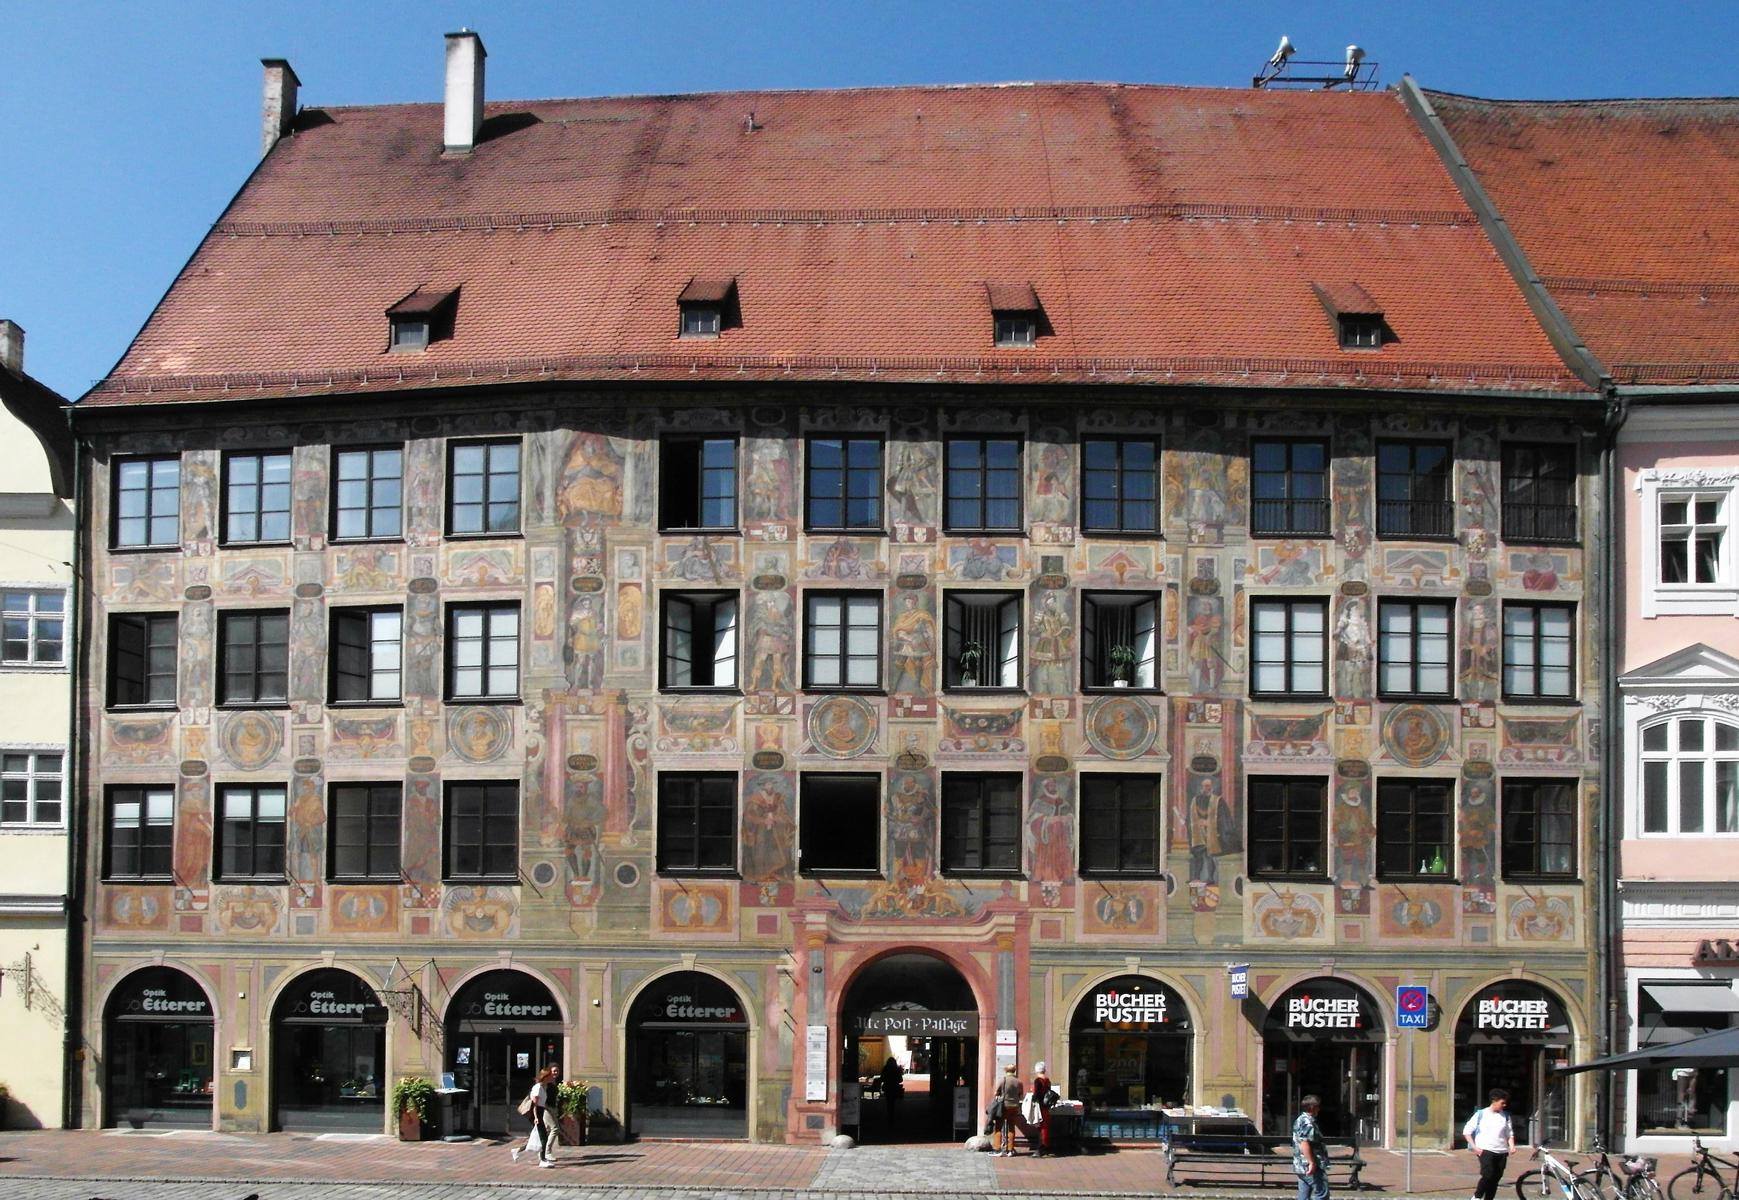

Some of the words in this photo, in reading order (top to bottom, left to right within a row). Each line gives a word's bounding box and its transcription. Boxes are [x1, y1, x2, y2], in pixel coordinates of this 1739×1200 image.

[143, 989, 166, 997] Optik
[310, 991, 334, 1000] Optik
[484, 993, 509, 1001] Optik
[667, 995, 691, 1003] Optik
[143, 998, 205, 1011] Etterer
[484, 1002, 552, 1015] Etterer
[666, 1004, 736, 1017] Etterer
[1400, 1014, 1424, 1024] TAXI
